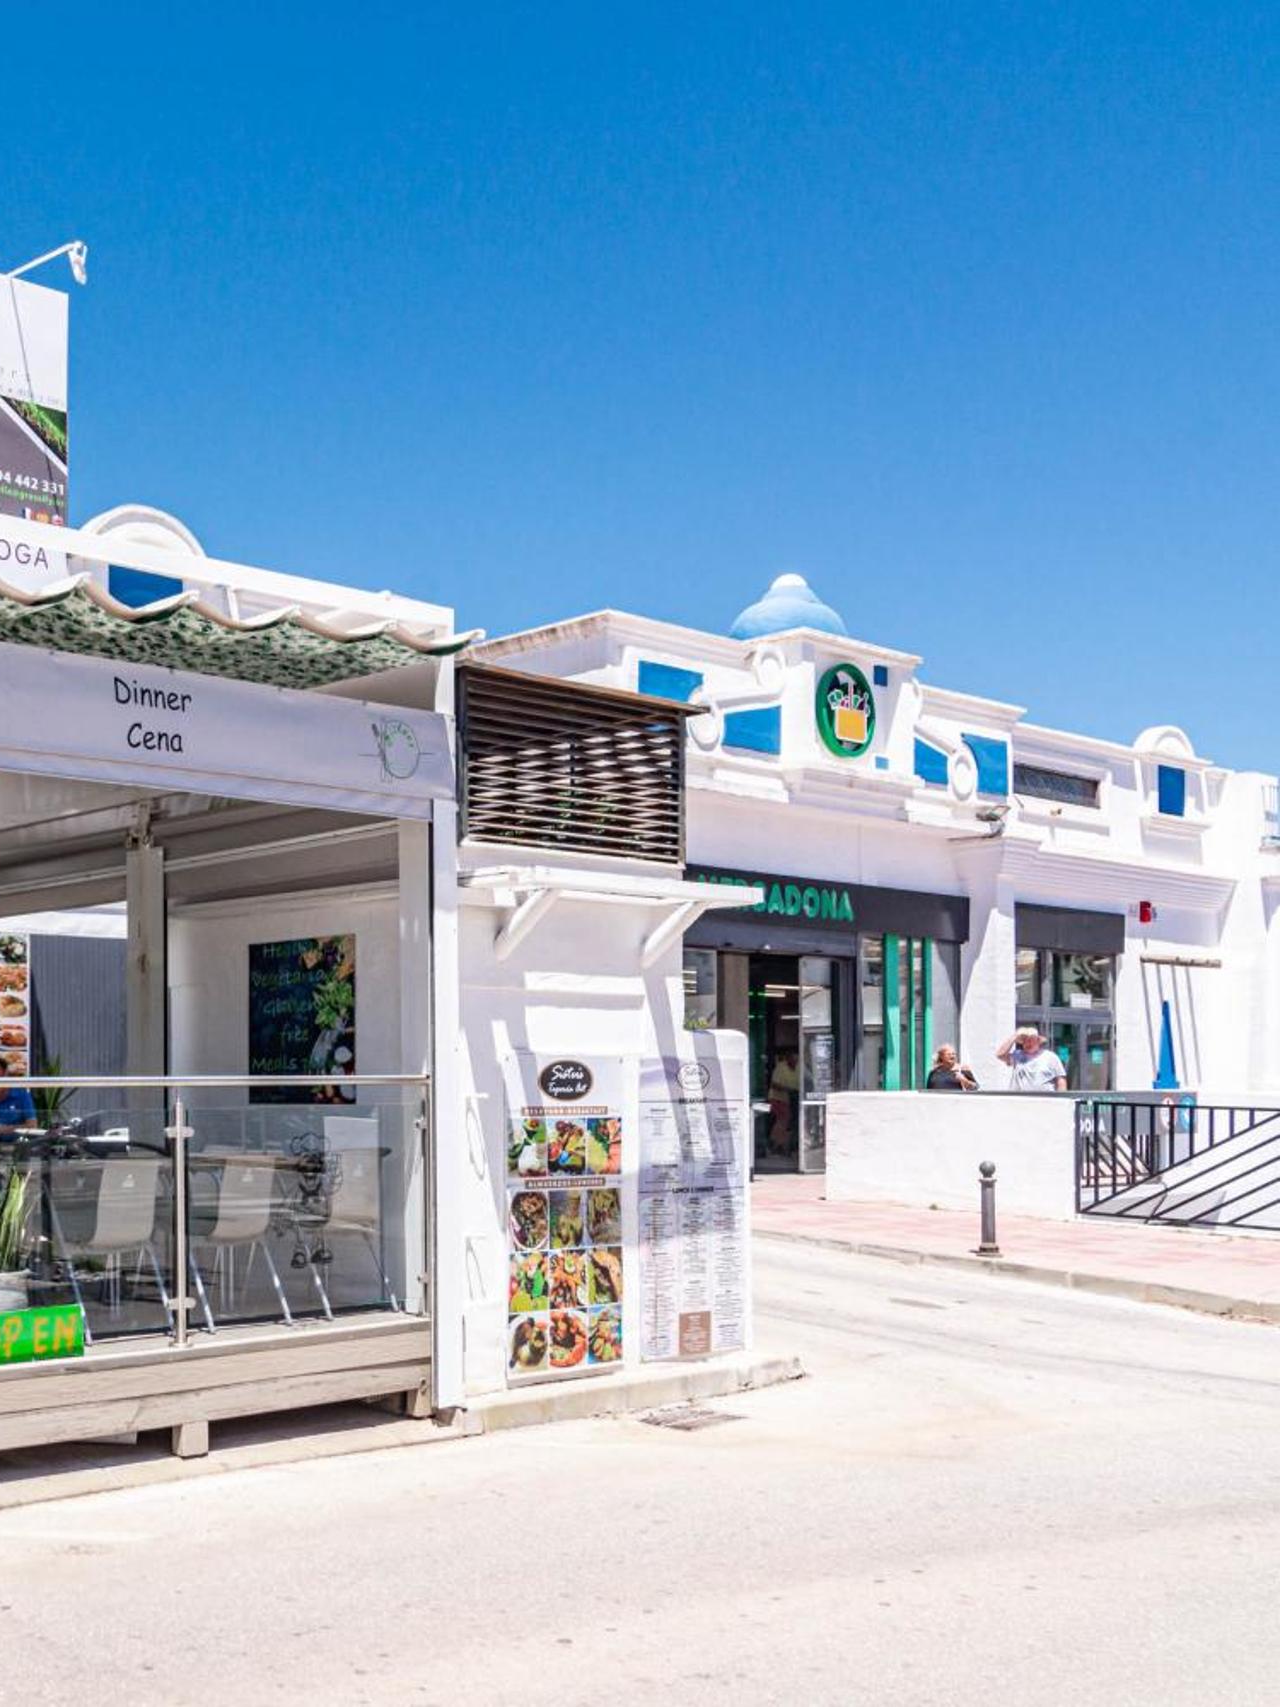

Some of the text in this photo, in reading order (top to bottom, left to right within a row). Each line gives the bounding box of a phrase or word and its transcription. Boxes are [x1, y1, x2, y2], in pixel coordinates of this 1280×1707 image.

[14, 474, 38, 490] 442
[41, 479, 65, 496] 331
[113, 676, 192, 712] Dinner
[127, 722, 183, 753] Cena
